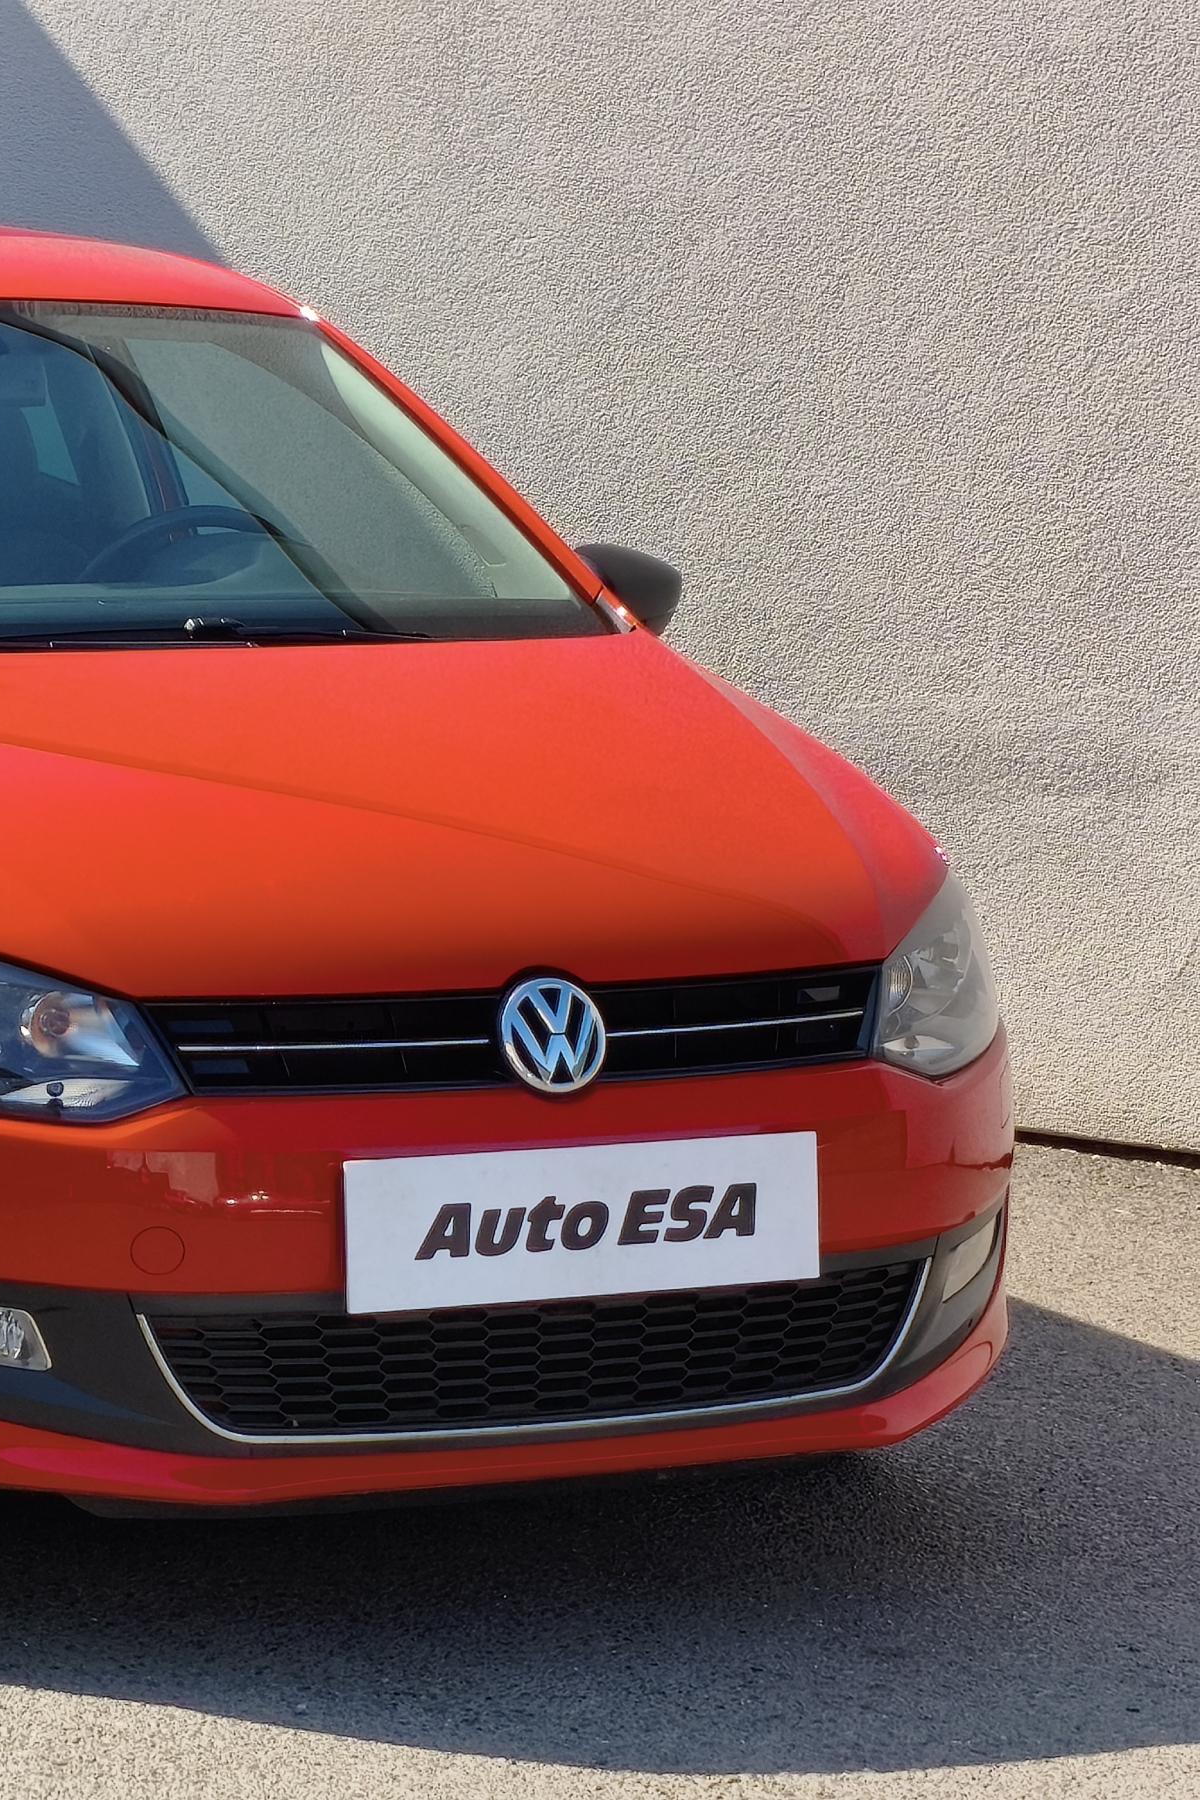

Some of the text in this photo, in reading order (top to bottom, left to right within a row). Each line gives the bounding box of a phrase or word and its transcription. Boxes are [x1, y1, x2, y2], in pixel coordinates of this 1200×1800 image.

[503, 979, 604, 1090] VW
[414, 1182, 758, 1261] Auto ESA
